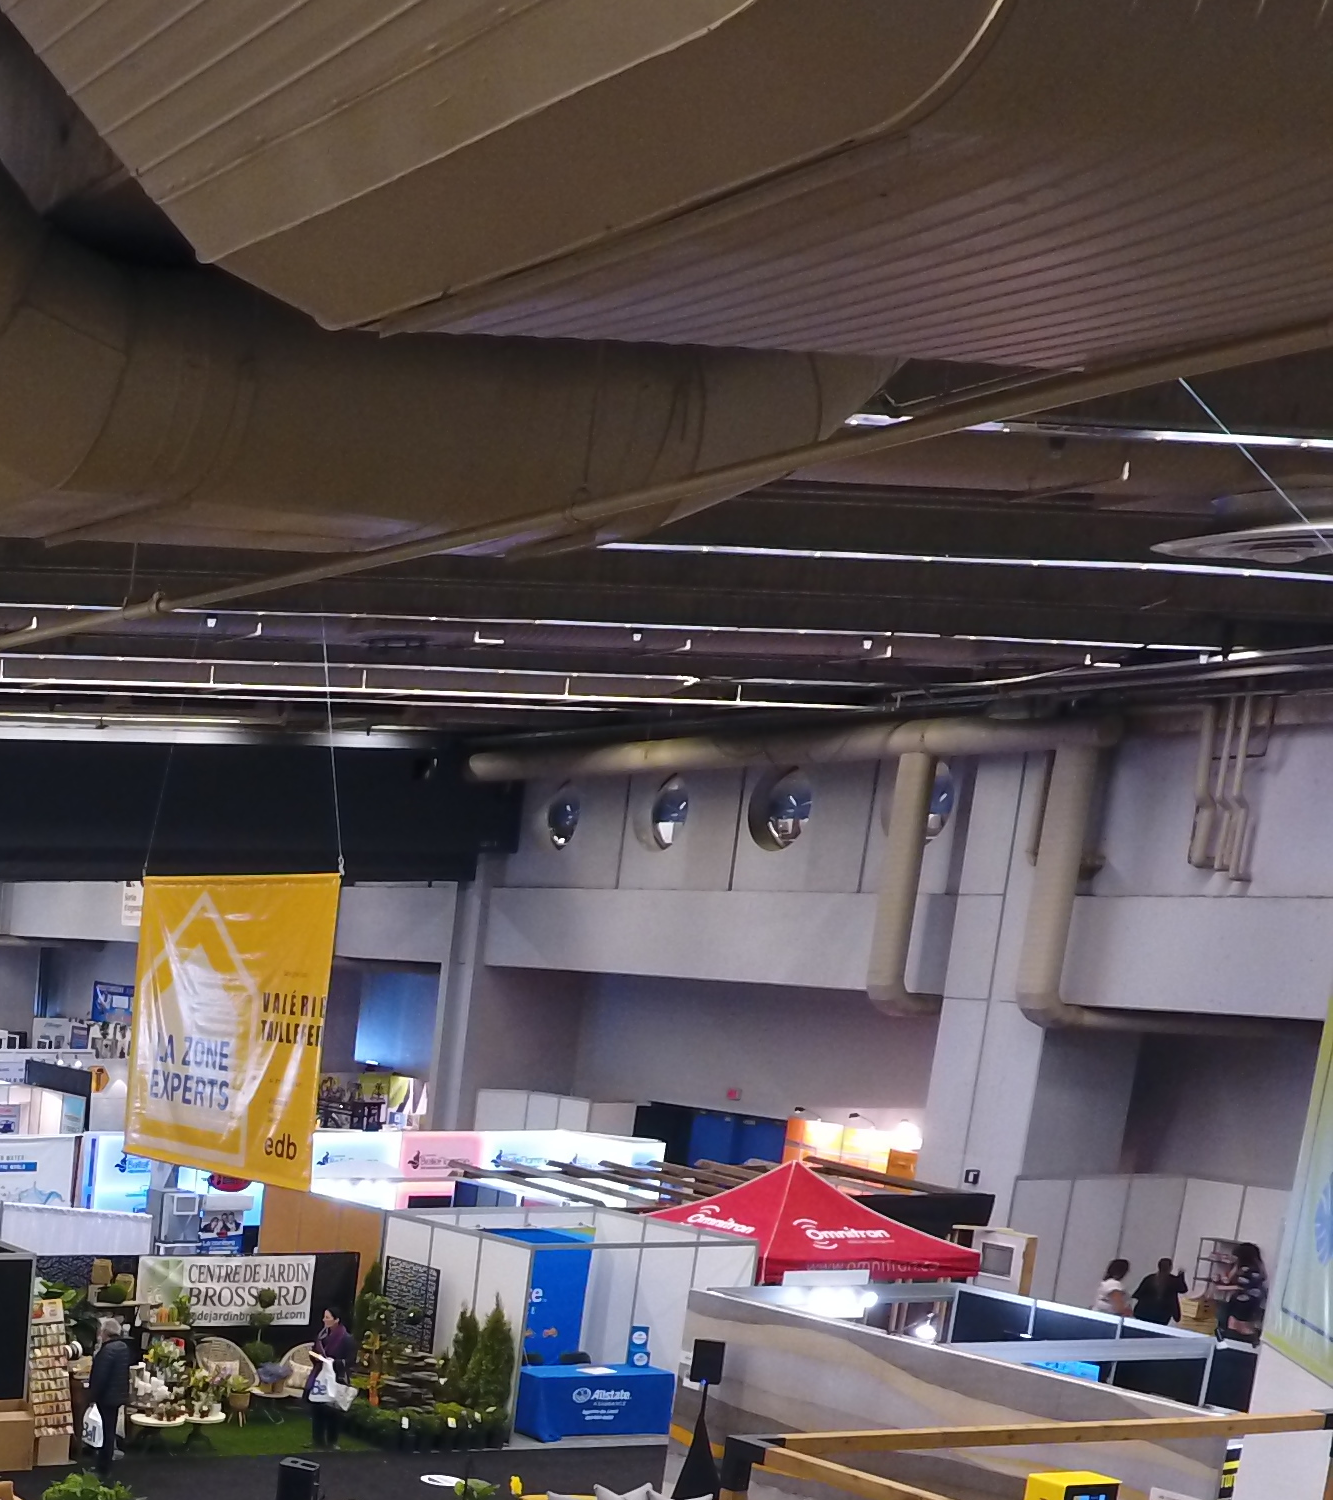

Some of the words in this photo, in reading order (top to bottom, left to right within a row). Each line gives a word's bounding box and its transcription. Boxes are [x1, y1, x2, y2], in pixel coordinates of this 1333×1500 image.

[155, 1031, 175, 1065] LA
[182, 1036, 231, 1072] ZONE
[149, 1070, 230, 1112] EXPERTS
[263, 1134, 297, 1162] edb
[686, 1210, 755, 1236] Omnitron
[805, 1226, 891, 1241] Omnitron
[188, 1263, 242, 1284] CENTRE
[243, 1264, 260, 1283] DE
[263, 1263, 311, 1283] JARDIN
[189, 1286, 307, 1307] BROSSRD
[590, 1388, 631, 1400] Allstate
